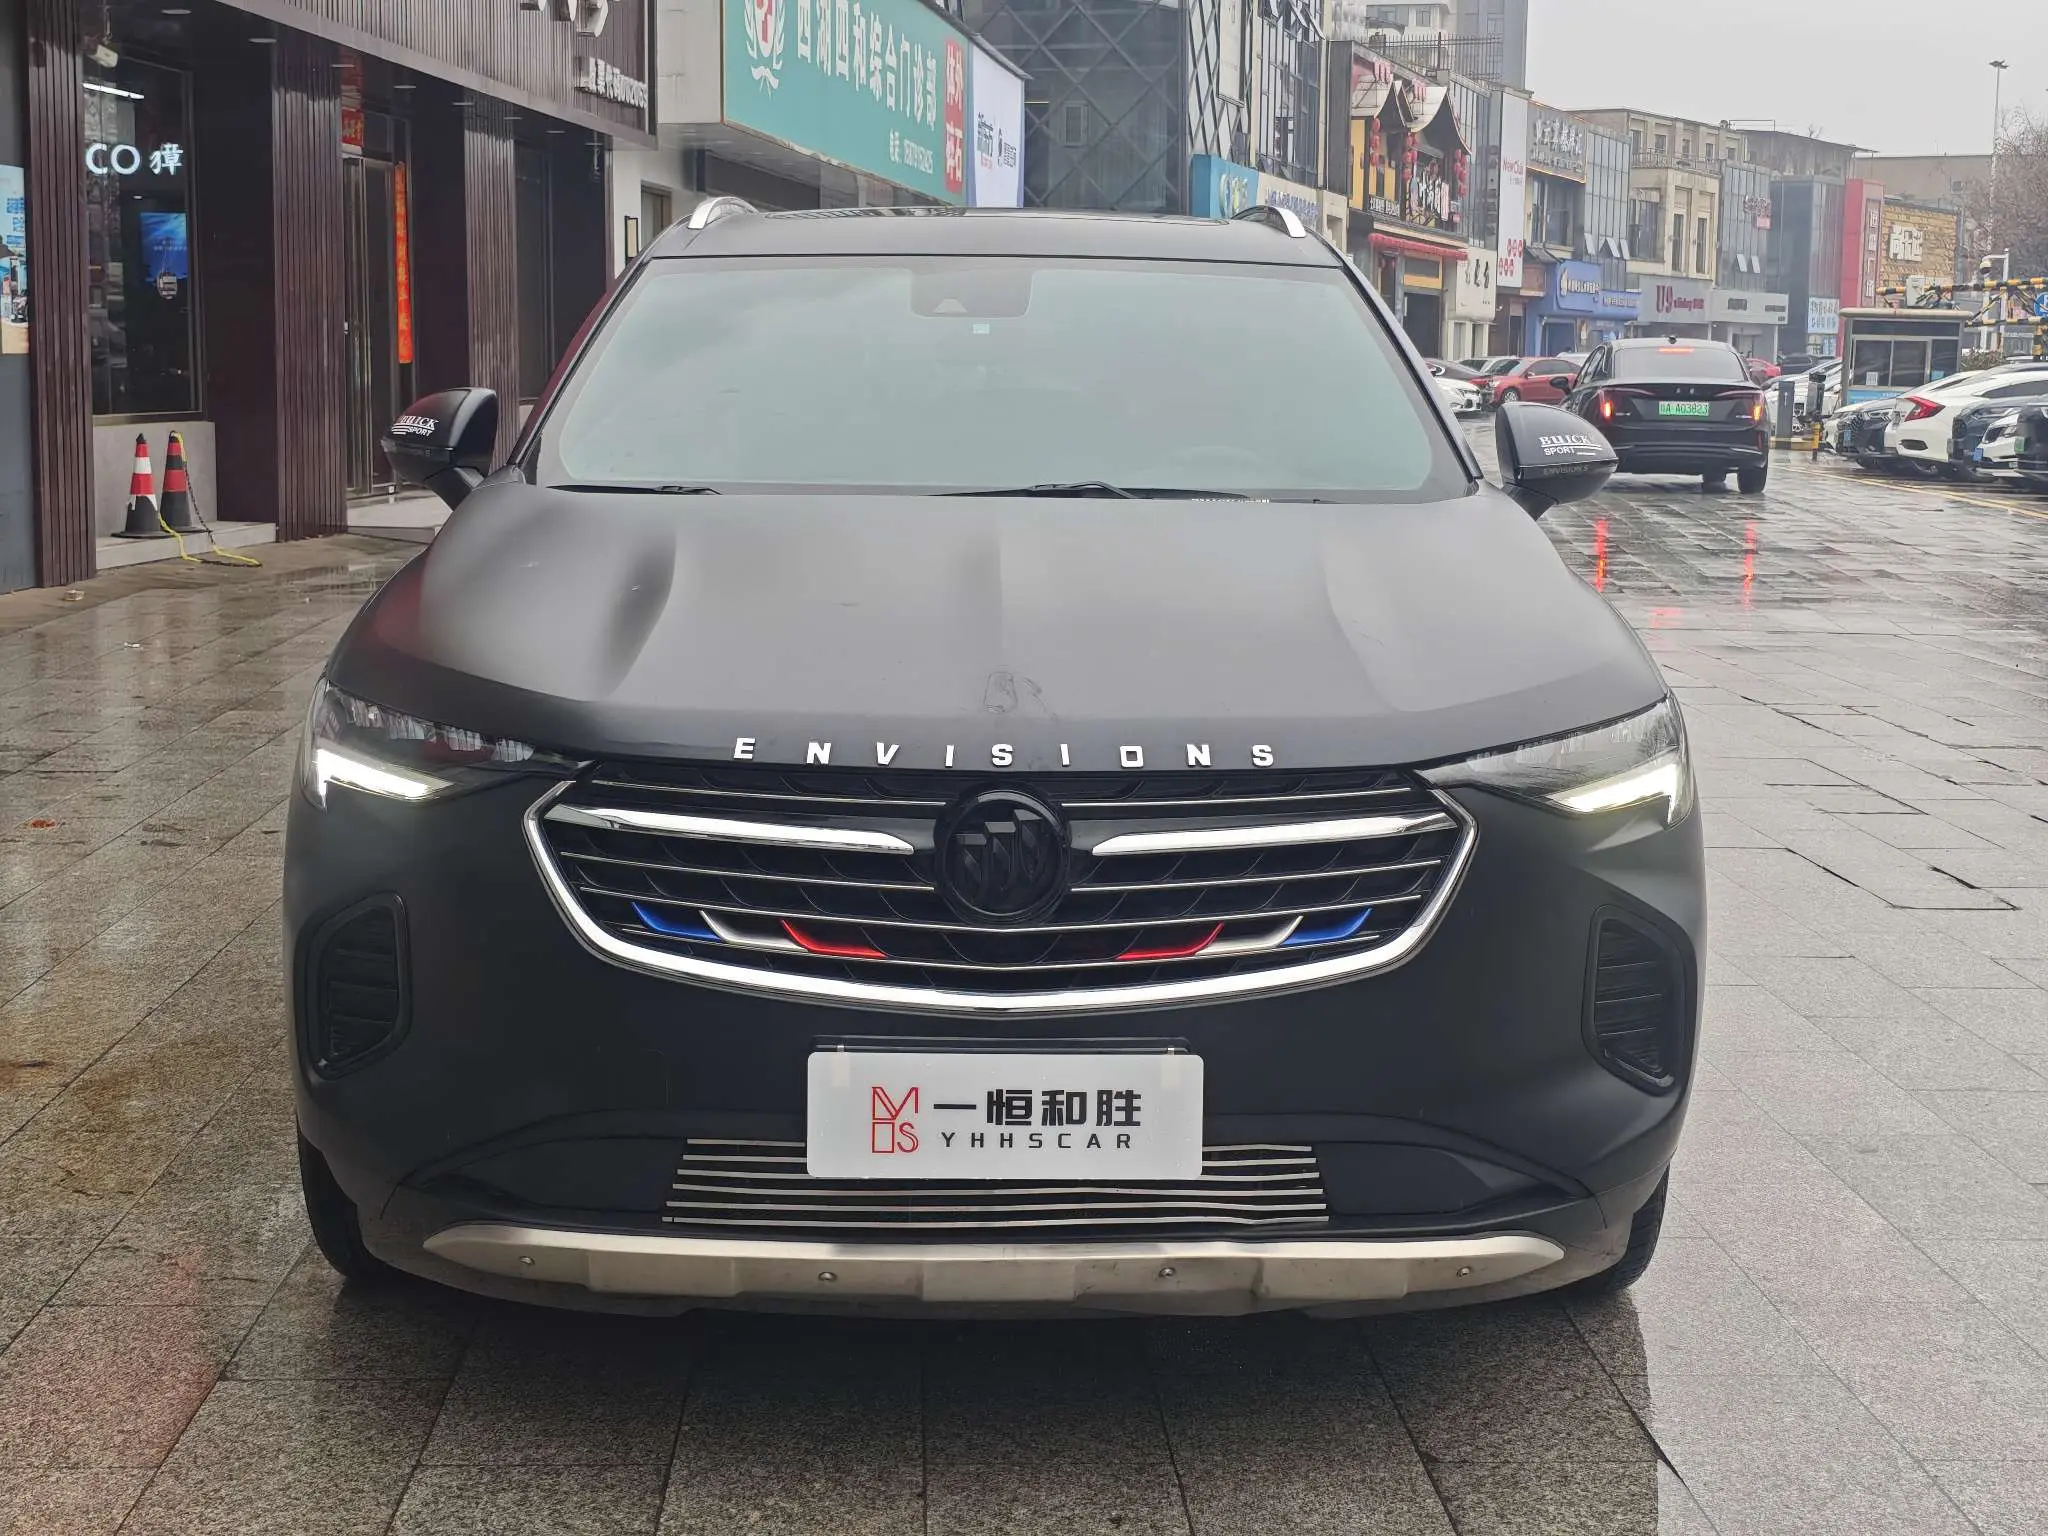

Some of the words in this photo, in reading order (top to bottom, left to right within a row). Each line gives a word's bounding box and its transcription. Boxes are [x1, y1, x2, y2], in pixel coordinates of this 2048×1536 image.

[85, 142, 142, 175] CO
[408, 426, 433, 436] SPORT
[1538, 434, 1591, 445] BUICK
[1543, 446, 1576, 456] SPORT
[733, 737, 1274, 767] ENVISIONS
[933, 1088, 1142, 1127] 一恒和胜
[941, 1132, 1132, 1149] YHHSCAR
